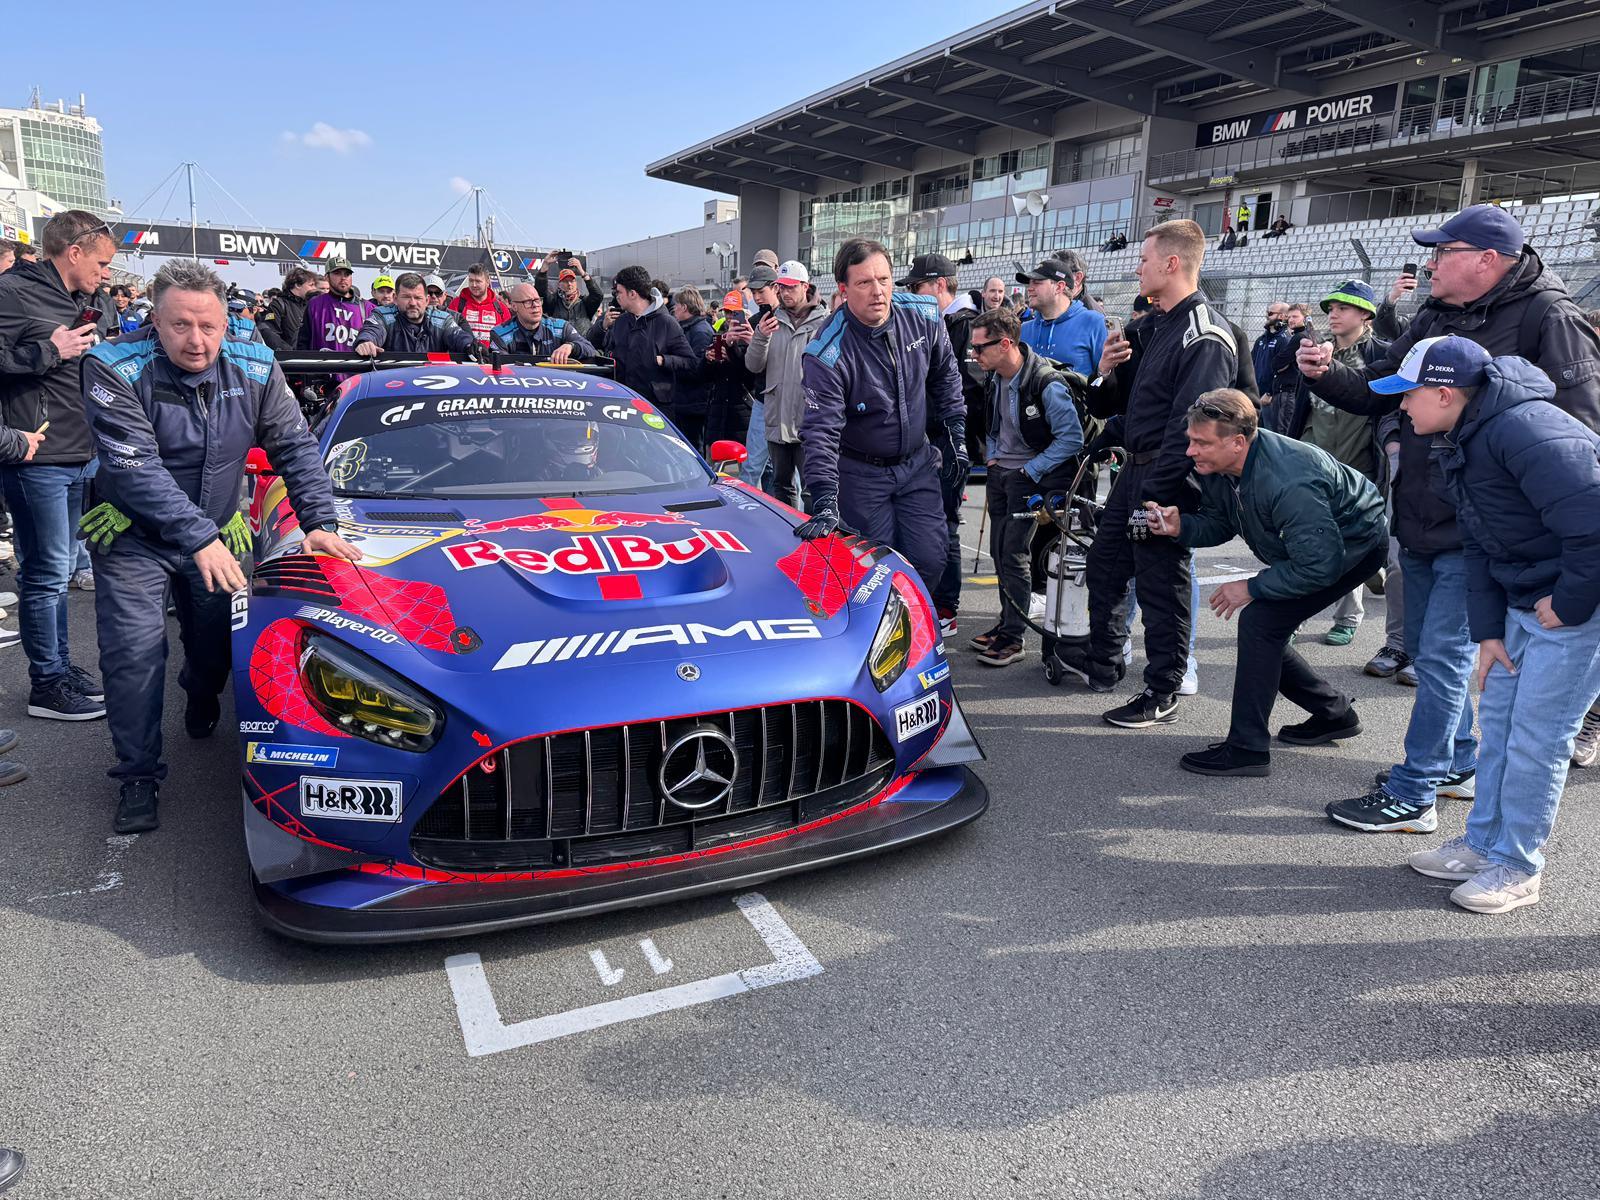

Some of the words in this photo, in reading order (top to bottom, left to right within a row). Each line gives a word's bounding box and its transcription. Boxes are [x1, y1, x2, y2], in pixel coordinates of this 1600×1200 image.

[1212, 119, 1251, 143] BMW
[1306, 94, 1373, 125] POWER
[219, 233, 280, 256] BMW
[361, 243, 440, 265] POWER
[334, 307, 354, 321] TV
[325, 323, 359, 347] 205
[248, 364, 268, 375] OMP
[1434, 365, 1455, 373] DEKRA
[466, 375, 588, 390] viaplay
[92, 385, 114, 403] OMP
[436, 397, 495, 413] GRAN
[500, 397, 586, 411] TURISMO
[532, 409, 587, 417] SIMULATOR
[441, 535, 611, 575] Red
[601, 528, 752, 572] Bull
[231, 588, 248, 632] KEN
[611, 618, 823, 654] AMG
[899, 704, 924, 734] H&R
[269, 750, 330, 762] MICHELIN
[304, 783, 361, 813] H&R
